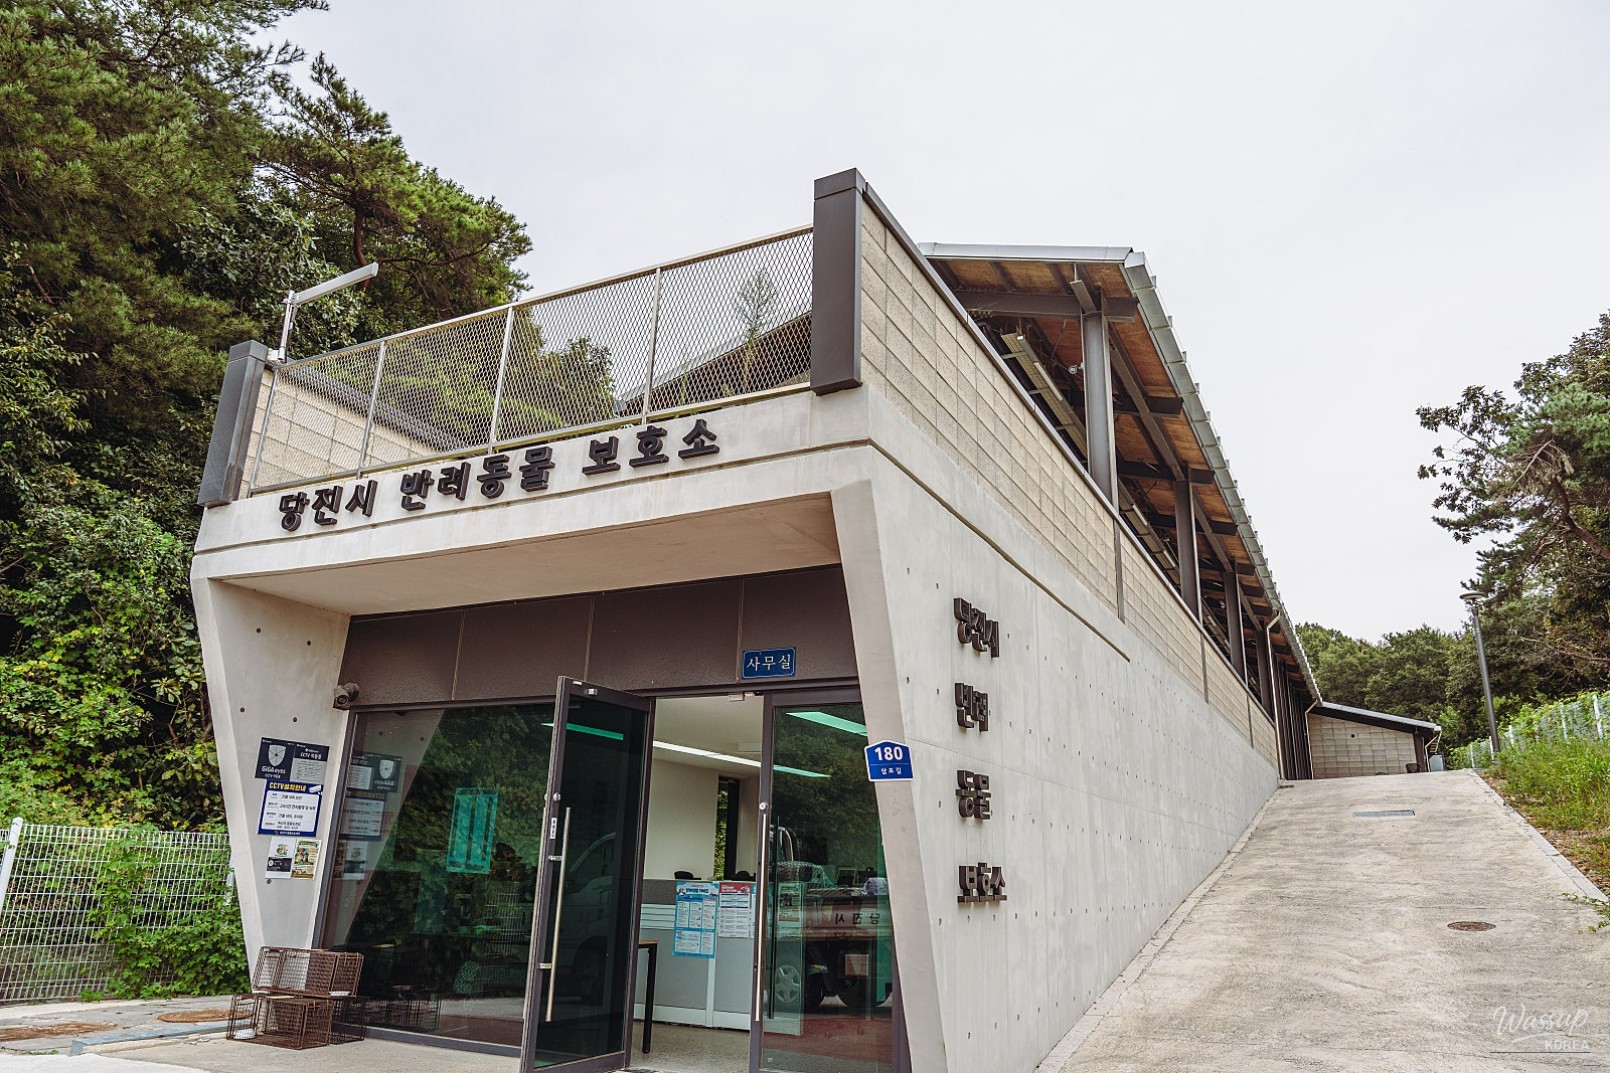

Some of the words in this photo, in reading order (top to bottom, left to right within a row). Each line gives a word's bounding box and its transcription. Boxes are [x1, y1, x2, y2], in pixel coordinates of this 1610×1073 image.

[279, 479, 378, 532] 당진시
[399, 445, 555, 511] 반려동물
[582, 418, 720, 475] 보호소
[953, 597, 999, 658] 당진시
[746, 654, 791, 671] 사무실
[955, 683, 988, 731] 반려
[874, 746, 903, 761] 180
[955, 769, 992, 820] 동물
[957, 862, 1007, 903] 보호소
